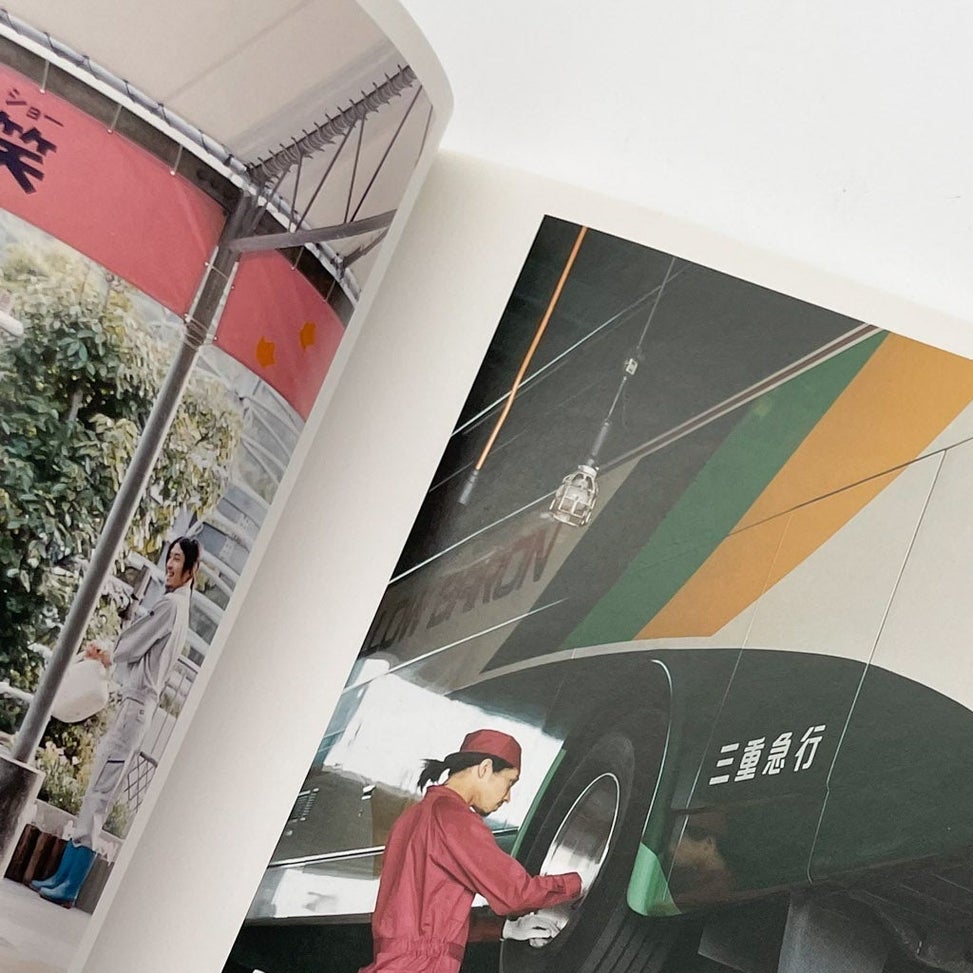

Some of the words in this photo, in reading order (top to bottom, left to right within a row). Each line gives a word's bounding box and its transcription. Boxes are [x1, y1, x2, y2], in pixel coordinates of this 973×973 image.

[5, 87, 65, 127] ショー
[709, 724, 826, 786] 三重急行
